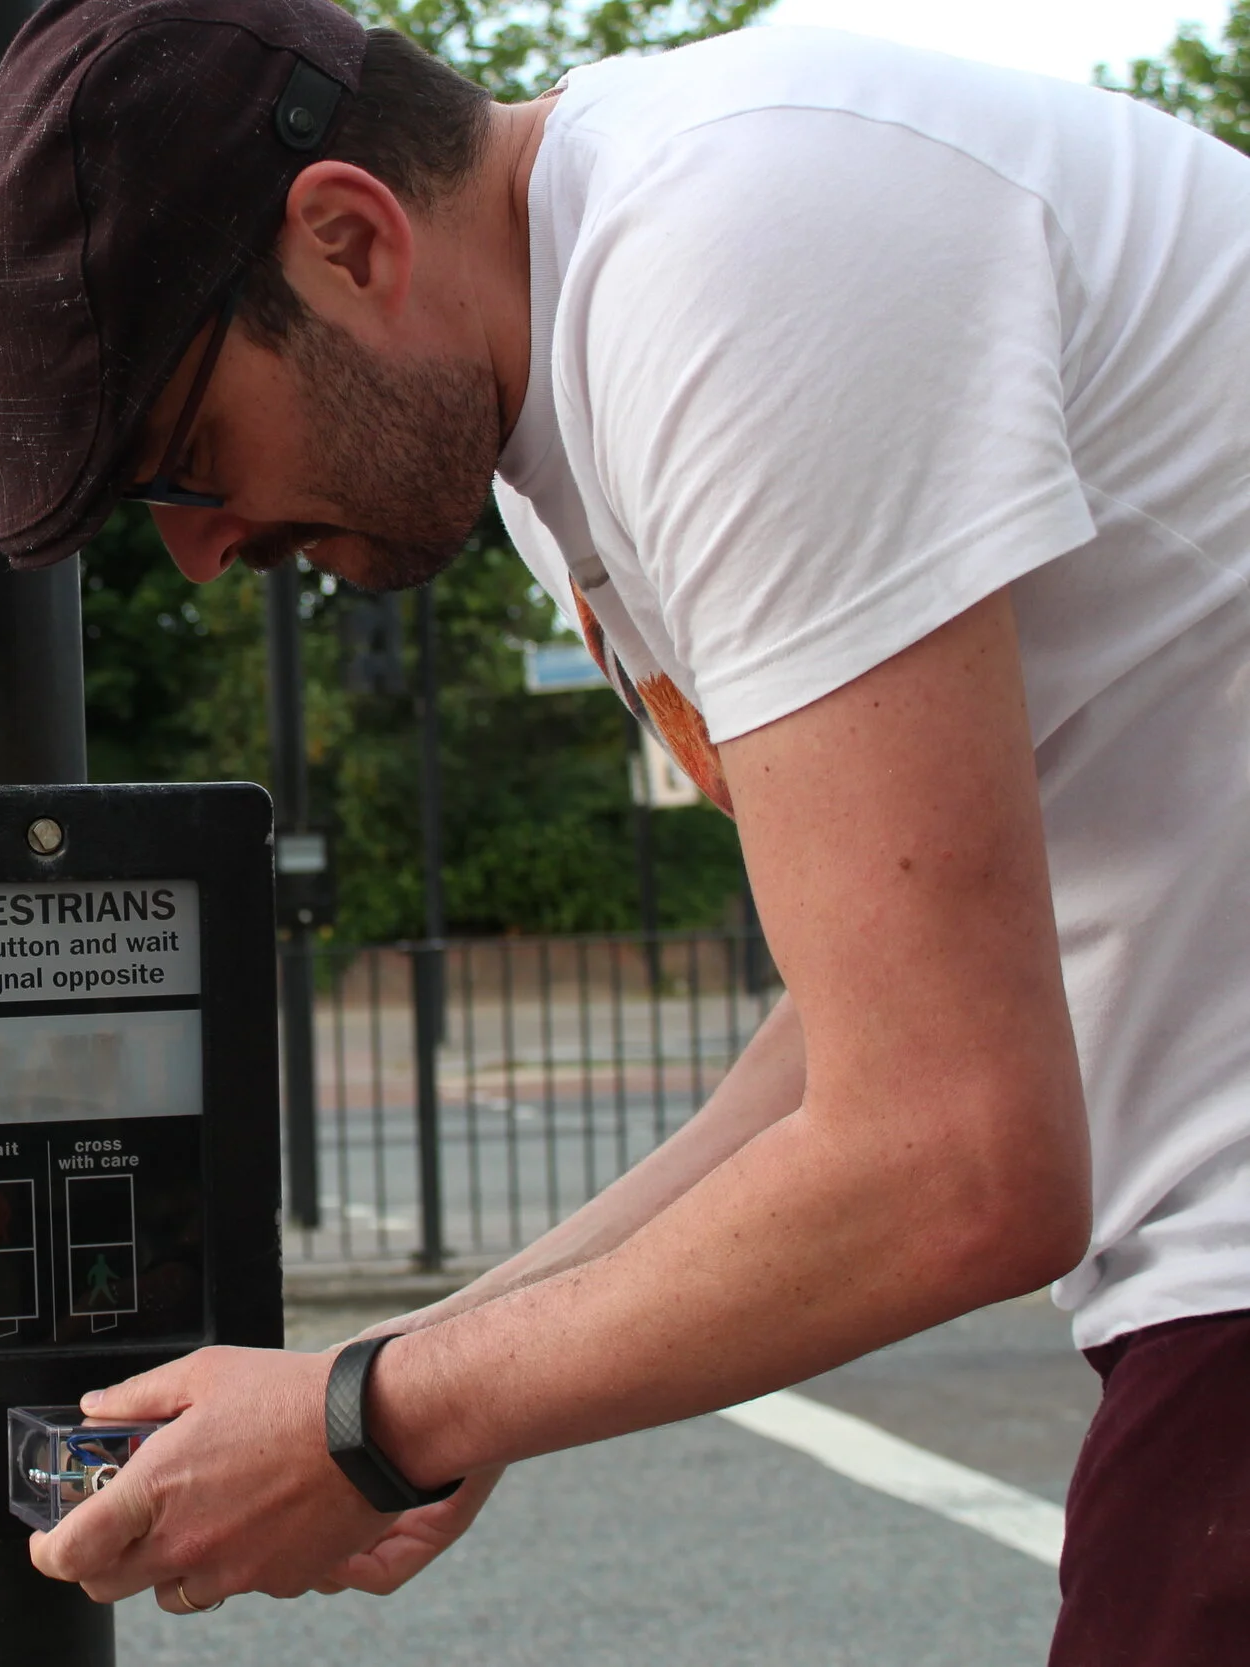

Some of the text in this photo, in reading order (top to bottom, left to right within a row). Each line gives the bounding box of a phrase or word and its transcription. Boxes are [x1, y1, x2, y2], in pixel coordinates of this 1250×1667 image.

[69, 932, 117, 955] and
[126, 931, 180, 953] wait
[52, 963, 165, 992] opposite
[74, 1139, 122, 1153] cross
[58, 1155, 140, 1170] with care
